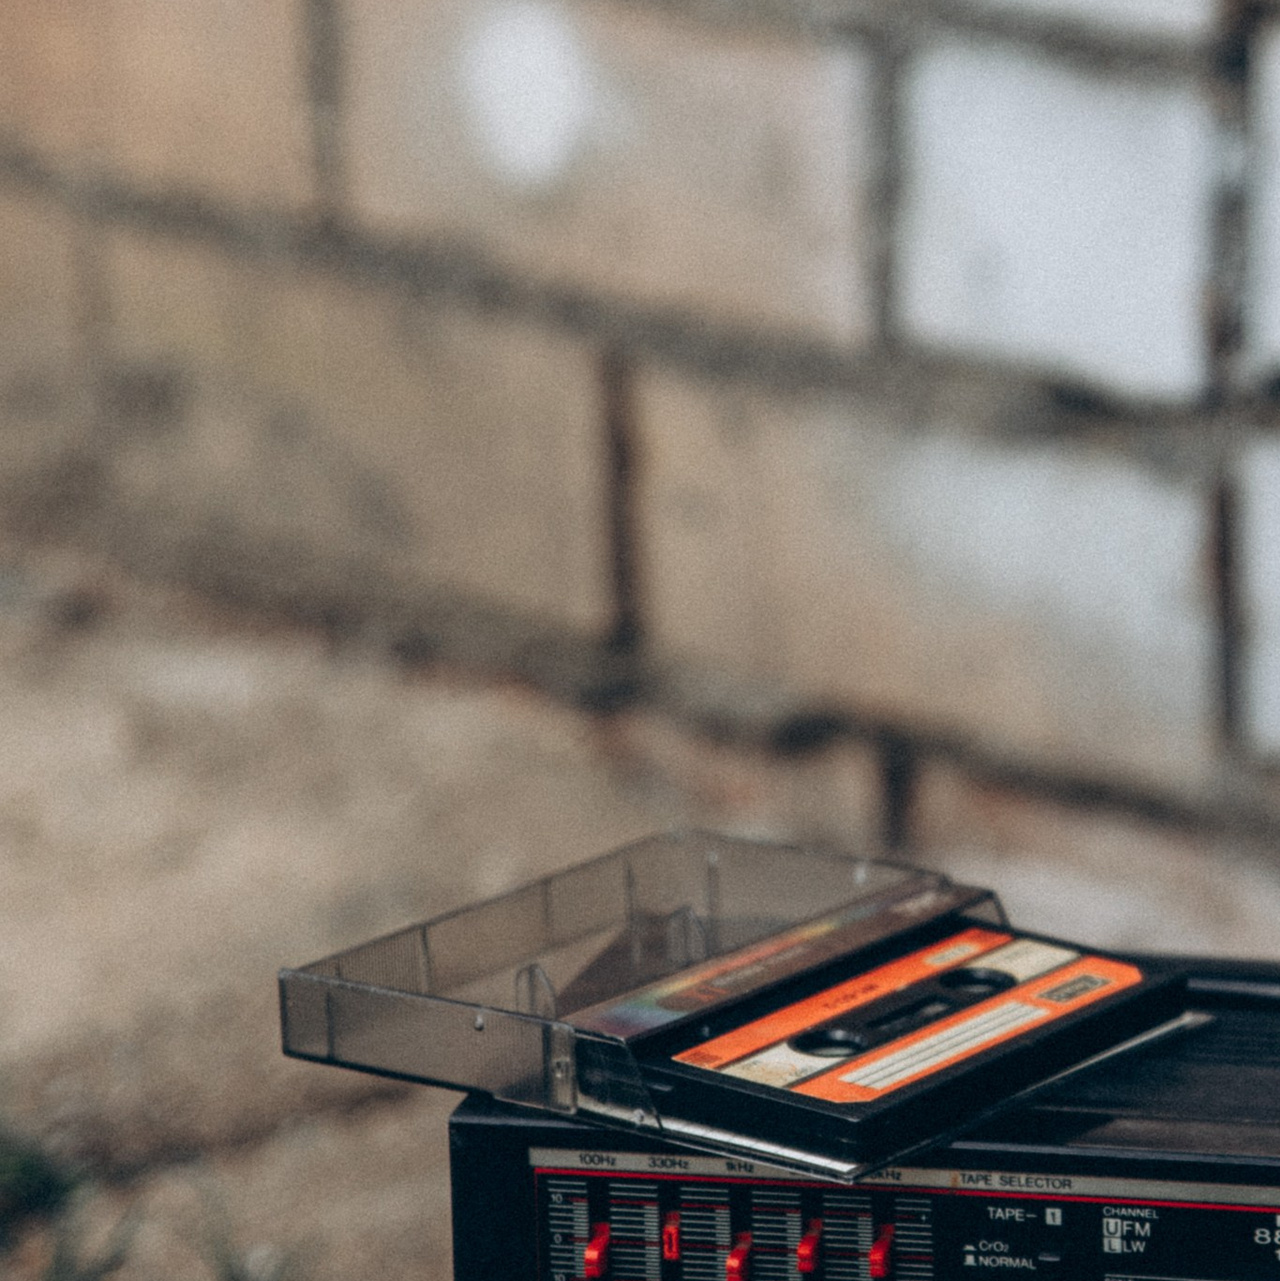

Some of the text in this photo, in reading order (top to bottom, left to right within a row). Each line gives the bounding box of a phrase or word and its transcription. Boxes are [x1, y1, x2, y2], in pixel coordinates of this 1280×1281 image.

[579, 1154, 617, 1167] 100Hz
[647, 1158, 690, 1170] 330Hz
[726, 1161, 755, 1174] 1kHz
[960, 1173, 1073, 1190] TAPE SELECTOR
[550, 1194, 563, 1203] 10
[1102, 1206, 1160, 1219] CHANNEL
[979, 1255, 1036, 1270] NORMAL
